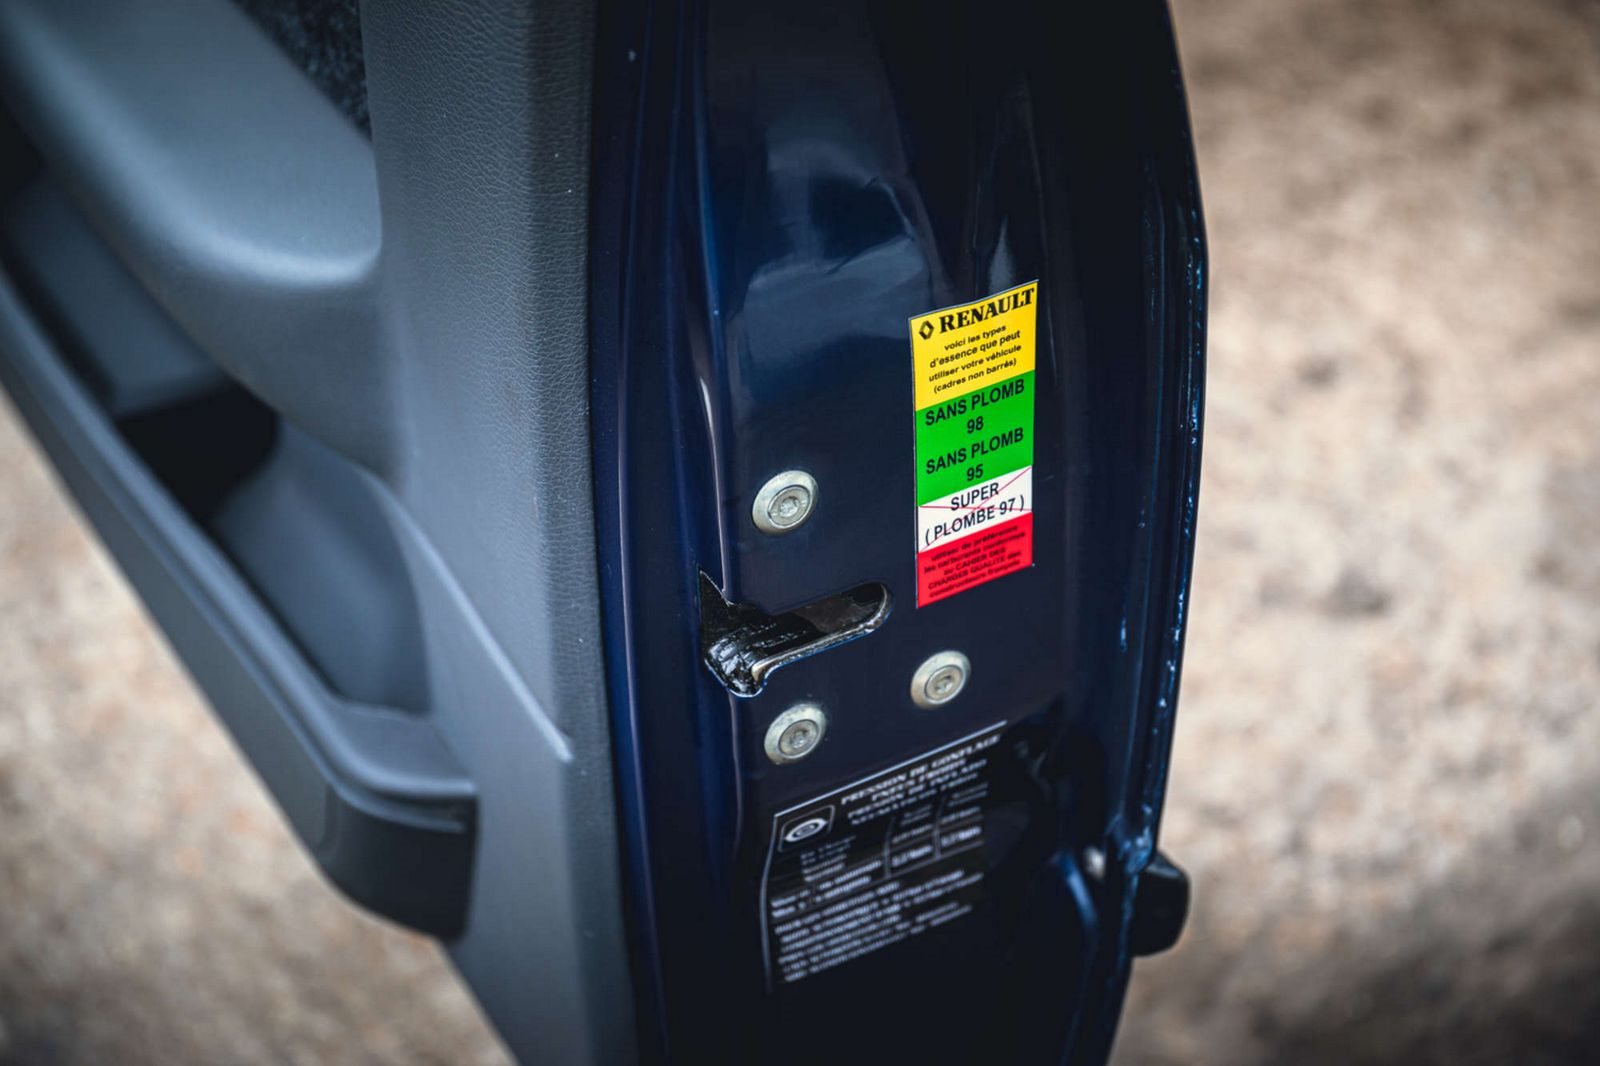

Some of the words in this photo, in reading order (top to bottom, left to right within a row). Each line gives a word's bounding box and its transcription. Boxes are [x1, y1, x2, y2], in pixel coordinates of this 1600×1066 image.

[939, 287, 1034, 334] RENAULT
[930, 346, 978, 368] d'essence
[980, 339, 998, 352] que
[999, 330, 1020, 347] peut
[944, 338, 966, 351] voici
[968, 333, 980, 344] les
[983, 325, 1006, 339] types
[929, 366, 959, 382] utiliser
[961, 358, 984, 371] votre
[986, 344, 1022, 361] véhicule
[933, 375, 966, 394] (cadres
[968, 371, 984, 381] non
[986, 357, 1017, 374] barrés)
[925, 399, 967, 426] SANS
[971, 379, 1025, 410] PLOMB
[967, 416, 984, 434] 98
[926, 447, 967, 475] SANS
[971, 427, 1024, 459] PLOMB
[967, 464, 984, 482] 95
[951, 482, 999, 511] SUPER
[989, 547, 1006, 559] DES
[928, 569, 969, 590] CHARGES
